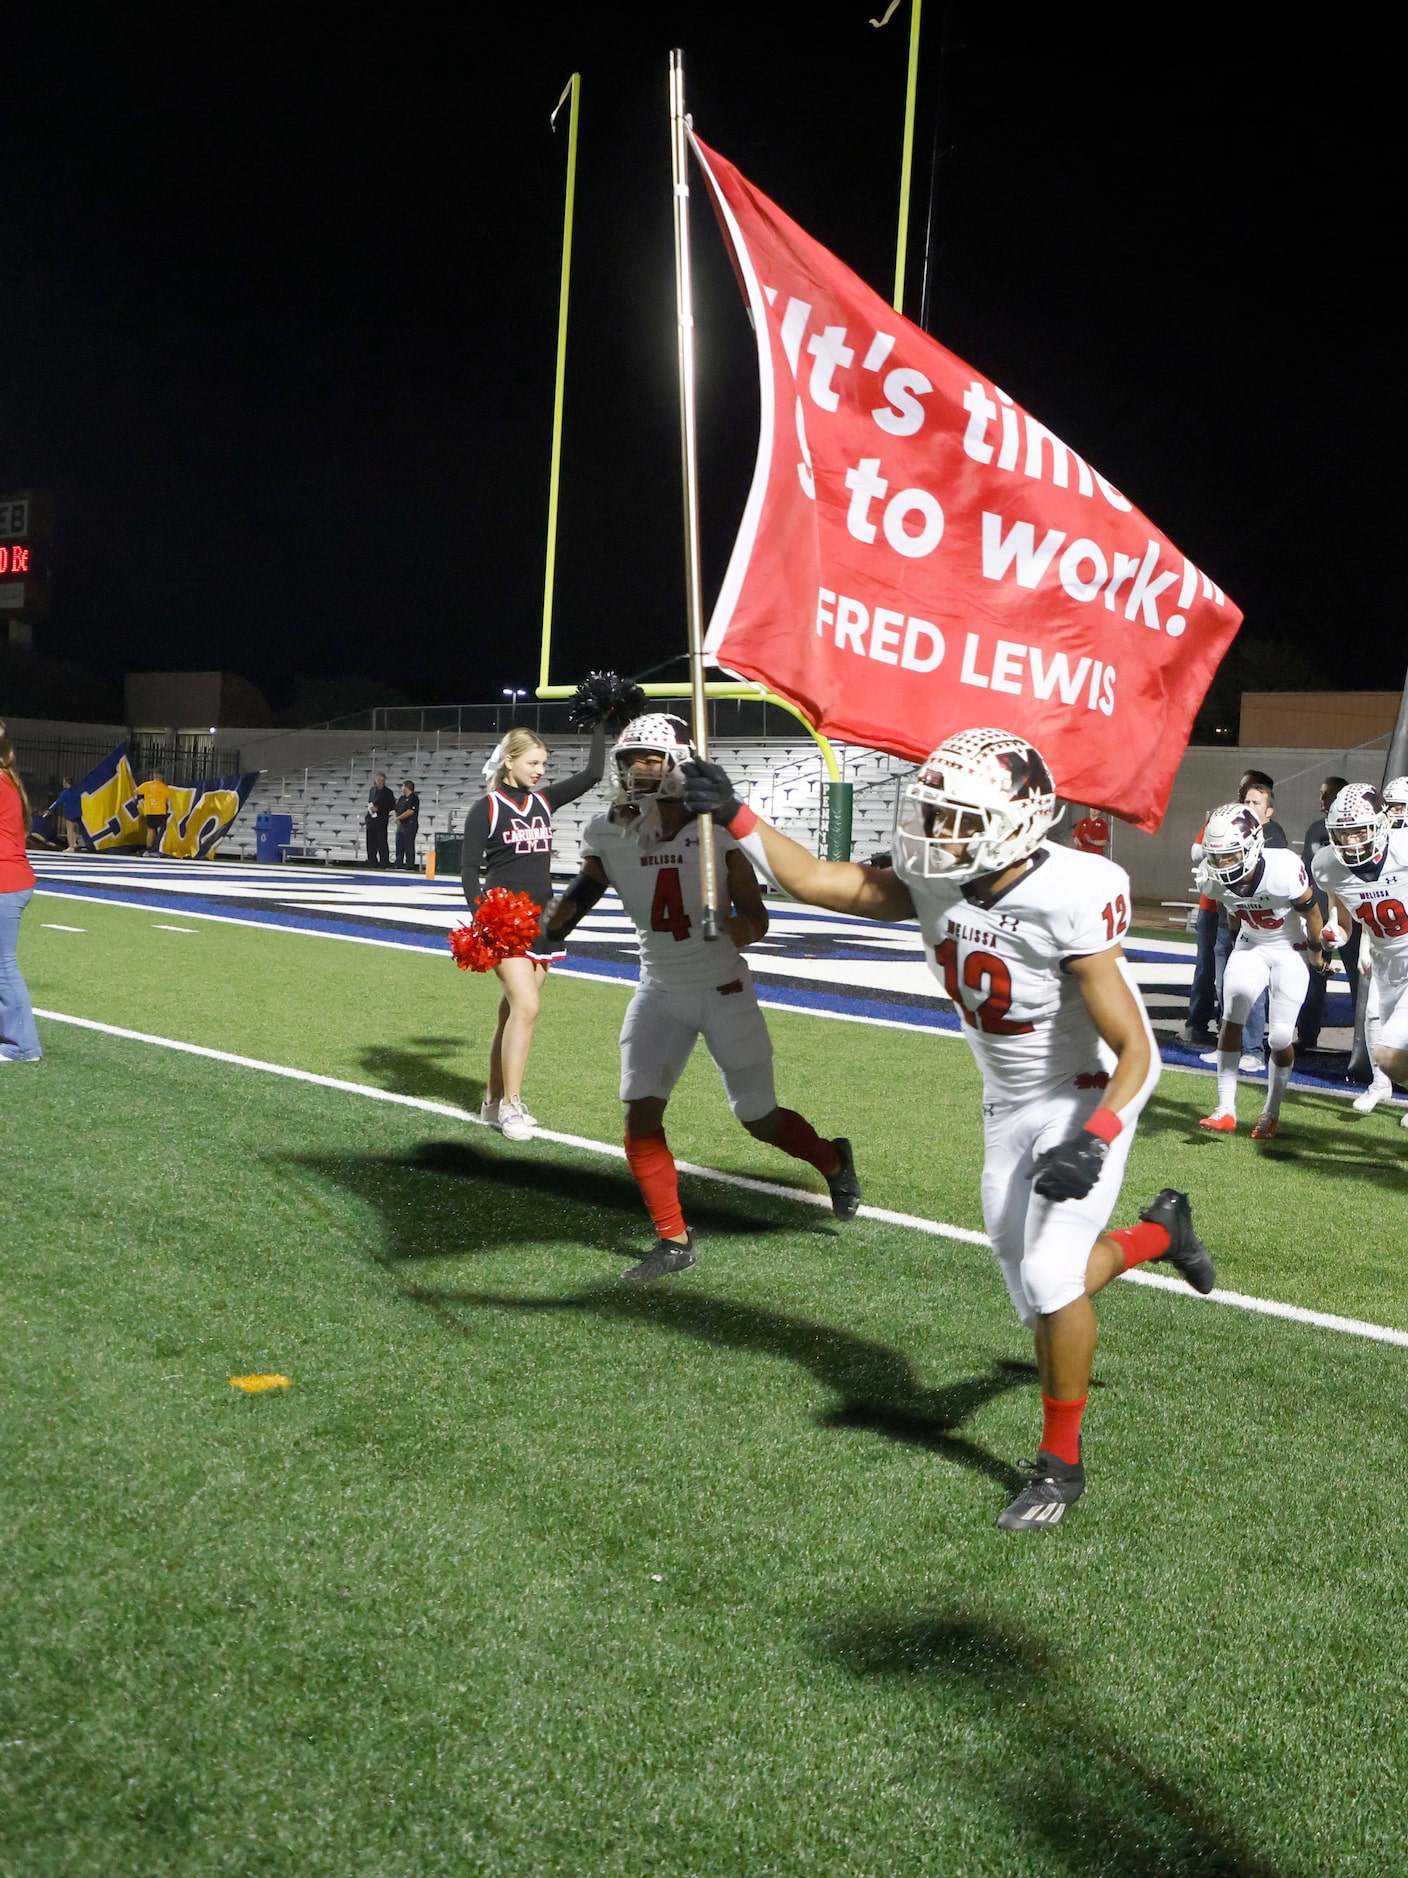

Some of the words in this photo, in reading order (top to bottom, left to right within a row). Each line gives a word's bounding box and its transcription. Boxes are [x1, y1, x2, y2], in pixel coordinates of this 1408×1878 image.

[844, 458, 945, 558] to
[816, 587, 945, 673] FRED
[960, 632, 1116, 717] LEWIS
[640, 854, 684, 867] MELISSA
[652, 867, 692, 942] 4
[1101, 894, 1127, 941] 12
[1359, 890, 1390, 900] MELISSA
[946, 919, 998, 949] MELISSA
[1235, 909, 1285, 930] 15
[934, 938, 1035, 1035] 12
